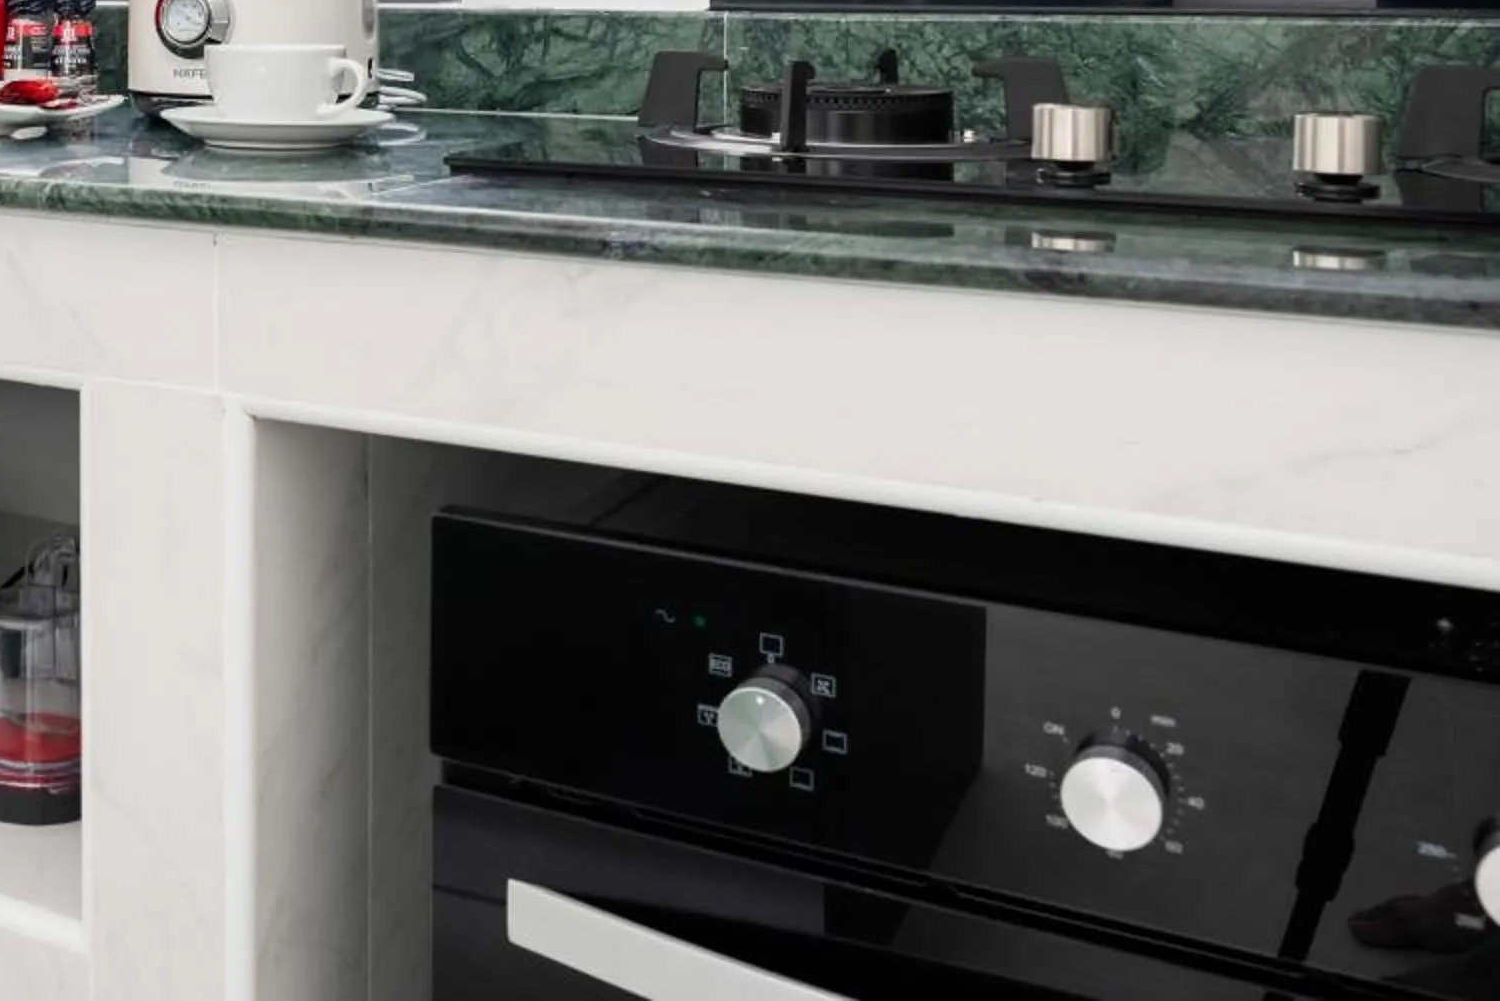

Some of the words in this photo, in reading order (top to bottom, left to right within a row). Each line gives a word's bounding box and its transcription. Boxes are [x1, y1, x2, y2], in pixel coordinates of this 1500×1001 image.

[173, 68, 207, 80] HAFE
[1110, 706, 1121, 720] 0
[1043, 721, 1065, 736] ON
